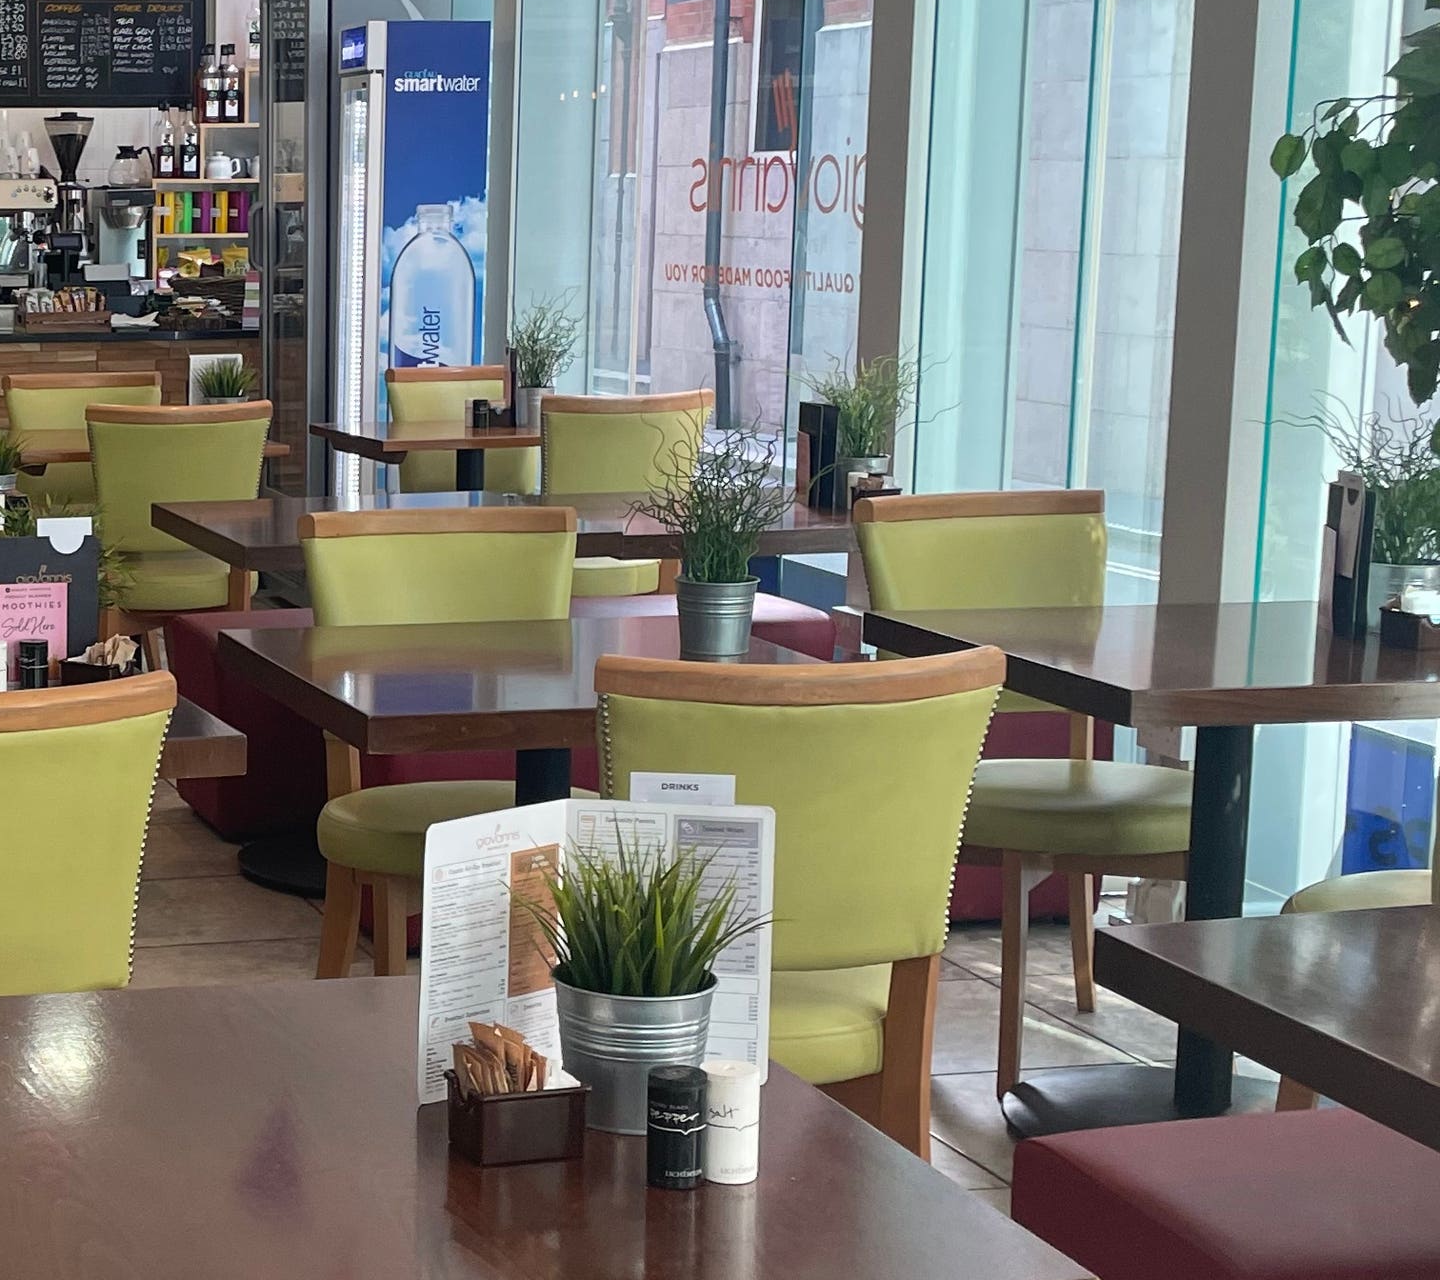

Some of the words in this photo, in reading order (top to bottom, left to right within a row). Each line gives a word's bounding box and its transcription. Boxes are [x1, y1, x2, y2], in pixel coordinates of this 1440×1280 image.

[394, 75, 480, 92] smartwater
[2, 618, 29, 638] Sold
[30, 616, 55, 637] Here
[661, 783, 699, 791] DRINKS
